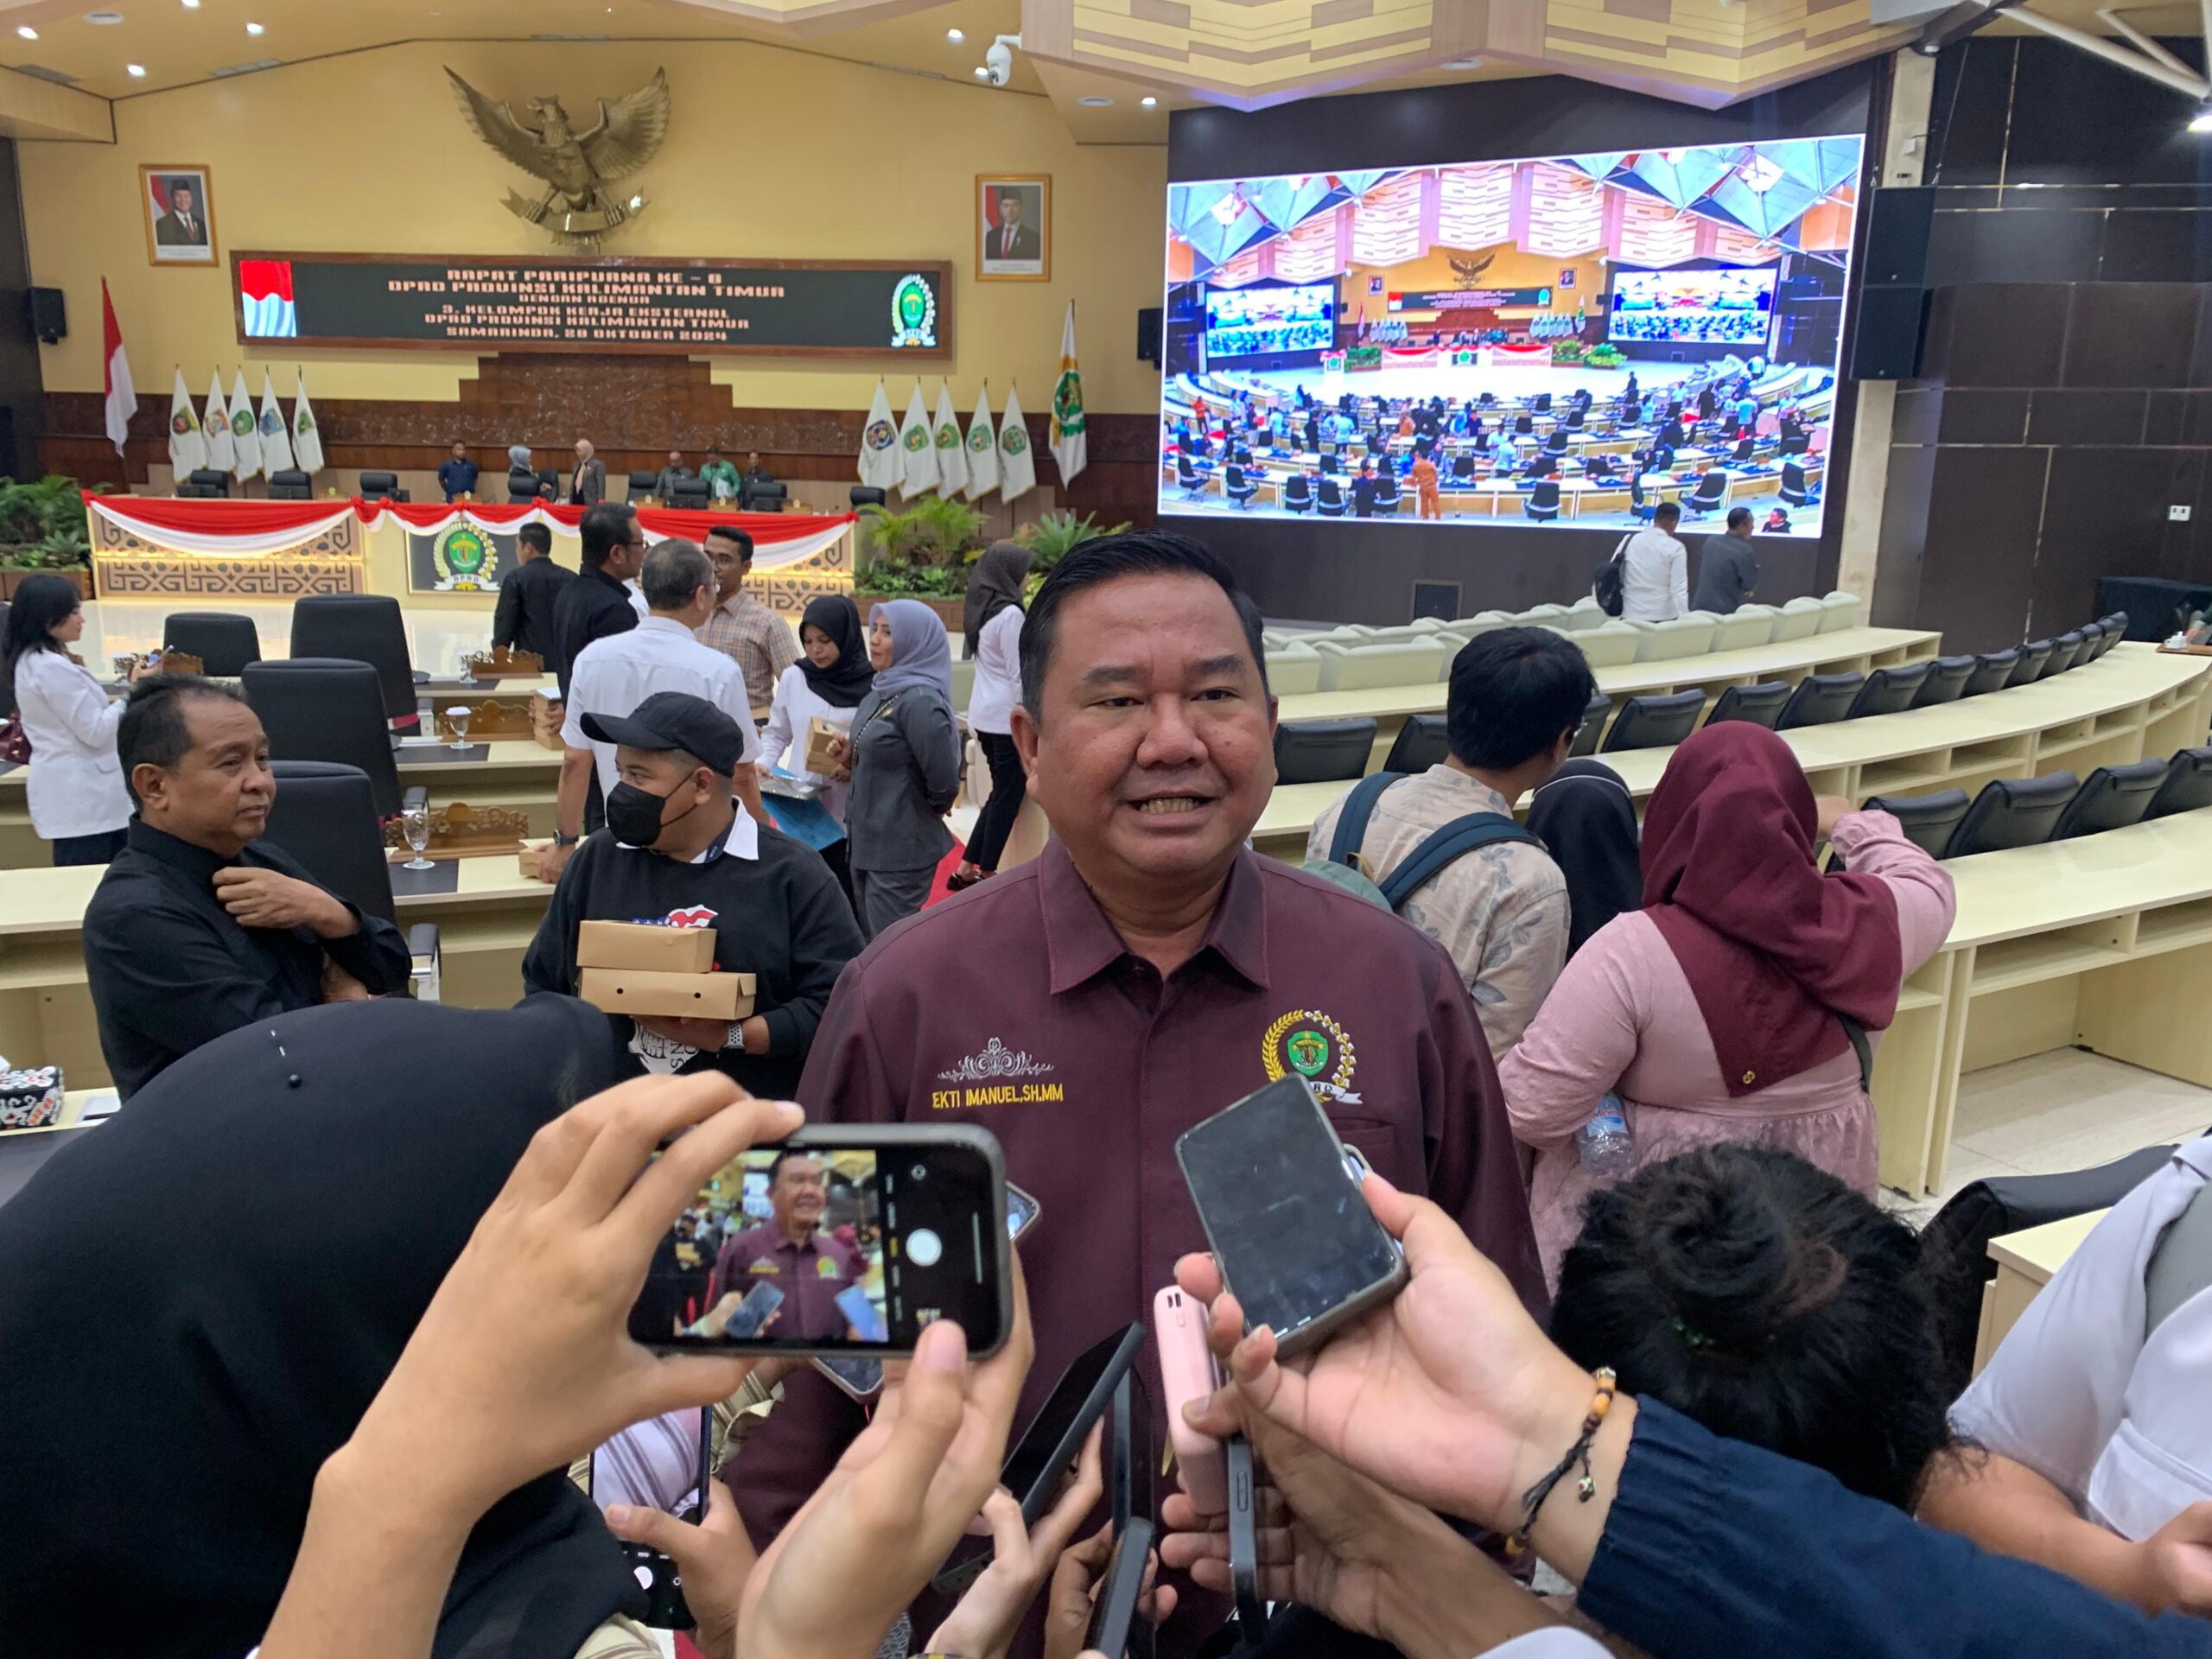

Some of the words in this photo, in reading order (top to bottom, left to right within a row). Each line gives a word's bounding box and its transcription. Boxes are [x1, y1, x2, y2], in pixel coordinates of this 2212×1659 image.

[447, 270, 518, 282] RAPAT
[524, 270, 651, 283] PARIPURNA
[657, 272, 683, 284] KE
[388, 280, 446, 292] DPRD
[451, 281, 556, 294] PROVINSI
[562, 283, 706, 296] KALIMANTAN
[713, 285, 785, 297] TIMUR
[518, 294, 582, 303] DENGAN
[587, 295, 650, 304] AGENDA
[465, 305, 561, 315] KELOMPOK
[565, 306, 623, 316] KERJA
[628, 308, 729, 319] EKSTERNAL
[424, 314, 471, 323] DPRD
[477, 315, 561, 325] PROVINSI
[566, 316, 685, 327] KALIMANTAN
[690, 319, 749, 329] TIMUR
[593, 329, 674, 340] OKTOBER
[931, 1090, 961, 1109] EKTI
